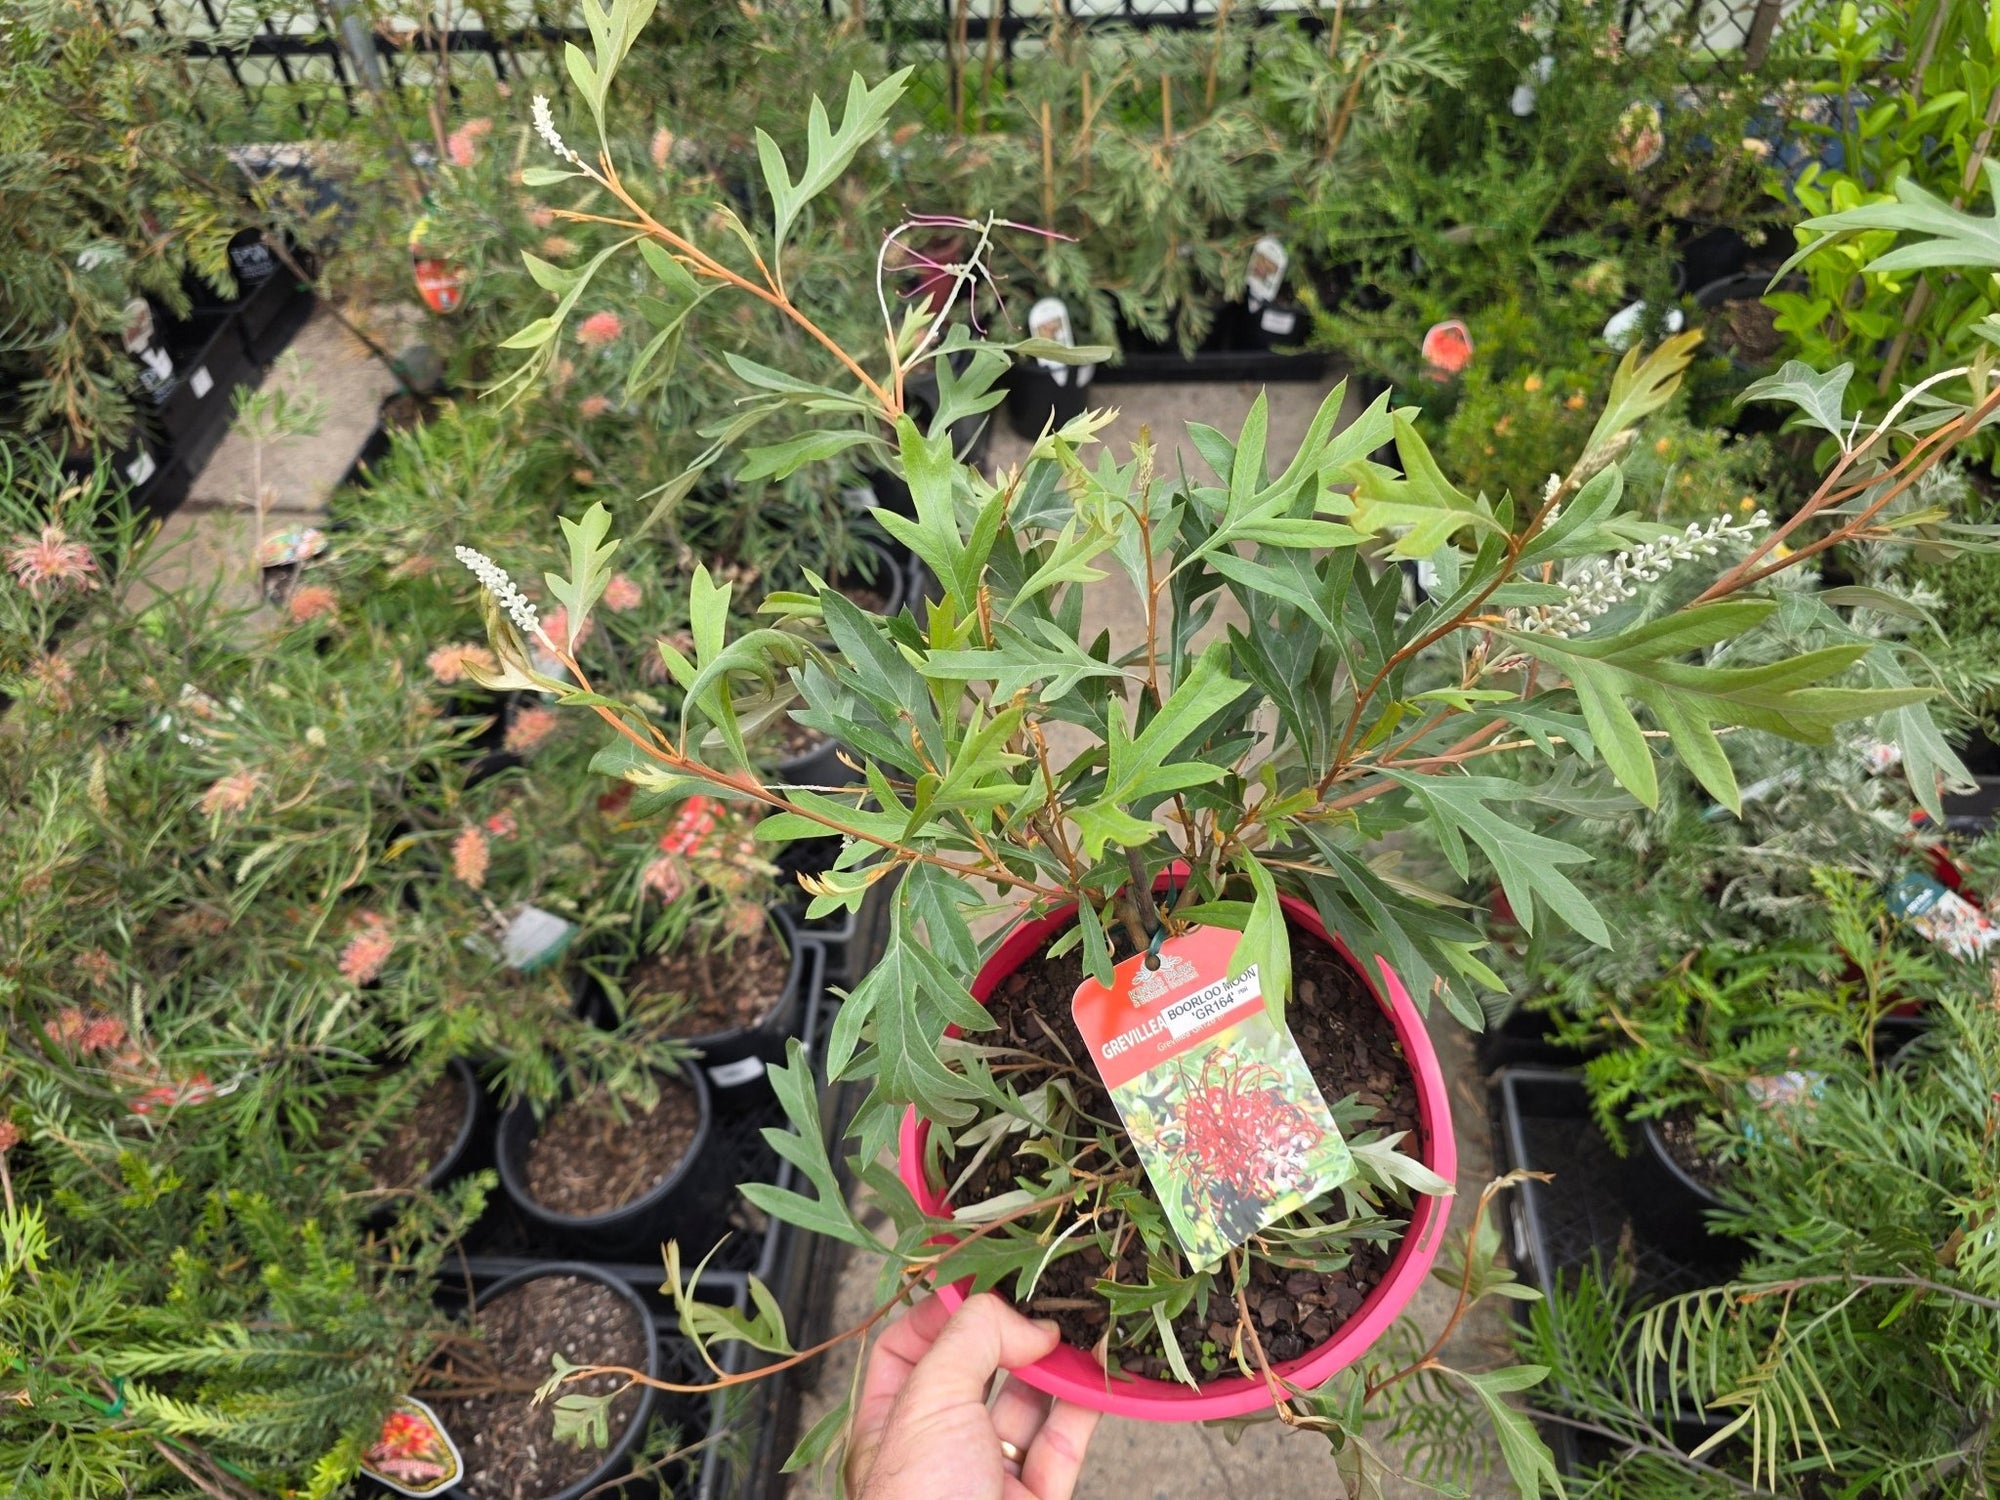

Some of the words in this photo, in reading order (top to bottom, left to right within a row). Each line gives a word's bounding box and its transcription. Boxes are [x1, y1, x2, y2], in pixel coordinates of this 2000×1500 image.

[1167, 986, 1221, 1020] BOORLOO
[1222, 968, 1257, 991] MOON
[1192, 992, 1234, 1020] 'GR164'
[1101, 1015, 1167, 1059] GREVILLEA
